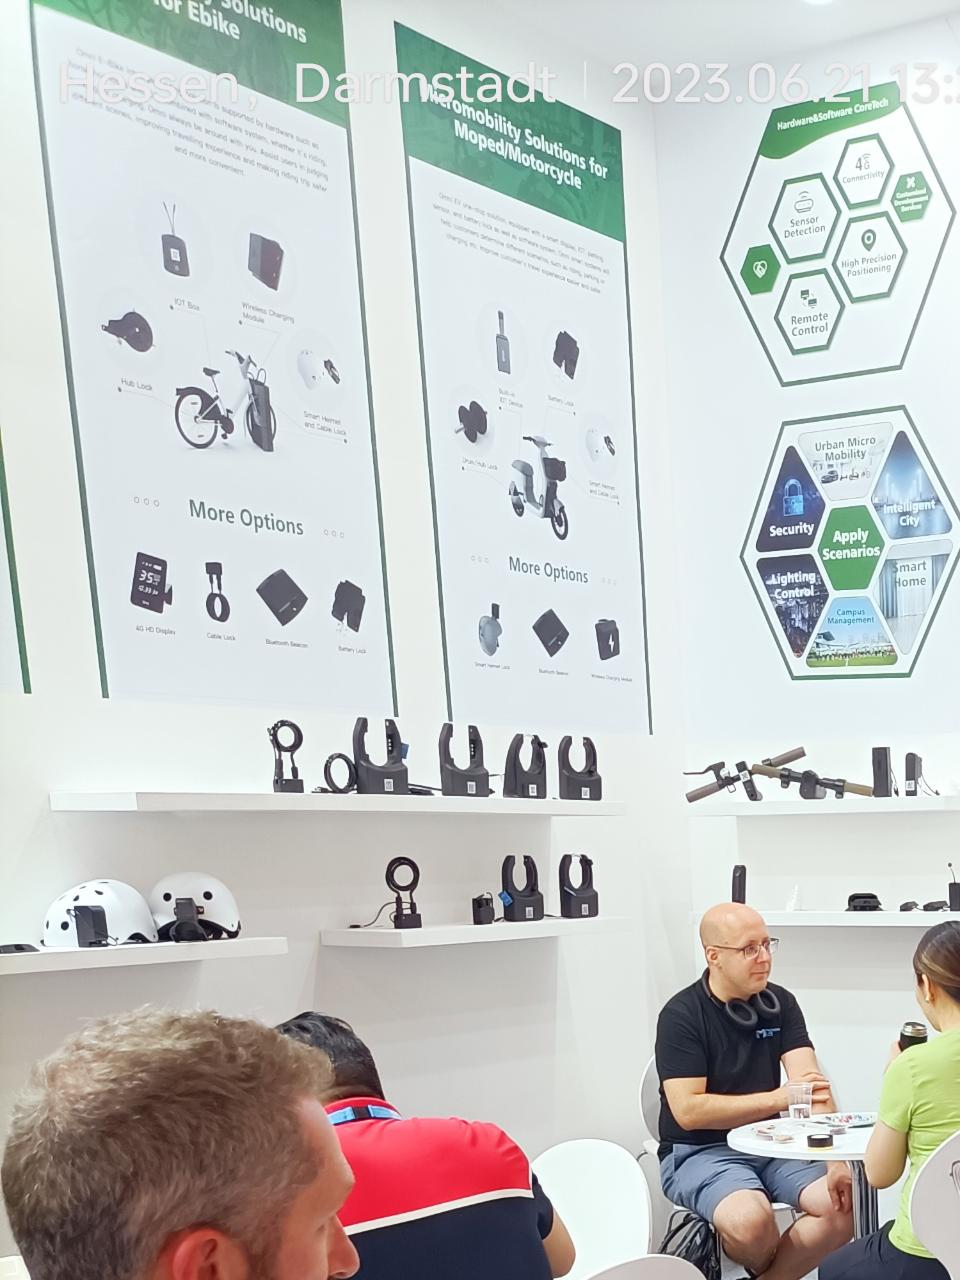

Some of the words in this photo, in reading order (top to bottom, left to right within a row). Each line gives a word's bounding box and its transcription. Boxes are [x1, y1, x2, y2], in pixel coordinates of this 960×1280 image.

[187, 1, 241, 40] Ebike
[777, 106, 853, 131] Hardware&Software
[854, 97, 889, 114] CoreTech
[453, 119, 583, 191] Moped/Motorcycle
[524, 127, 587, 171] Solutions
[589, 156, 609, 180] for
[842, 169, 885, 184] Connectivity
[790, 215, 819, 228] Sensor
[783, 223, 826, 239] Detection
[841, 258, 860, 271] High
[862, 252, 897, 267] Precision
[847, 263, 892, 278] Positioning
[791, 311, 829, 326] Remote
[791, 323, 829, 338] Control
[815, 439, 844, 452] Urban
[847, 435, 876, 448] Micro
[824, 449, 866, 463] Mobility
[883, 499, 936, 516] Intelligent
[189, 498, 235, 524] More
[240, 508, 304, 536] Options
[899, 515, 921, 528] City
[769, 522, 815, 537] Security
[833, 528, 869, 545] Apply
[822, 545, 881, 561] Scenarios
[508, 555, 541, 576] More
[543, 562, 589, 584] Options
[892, 559, 927, 574] Smart
[771, 571, 816, 587] Lighting
[895, 576, 927, 588] Home
[774, 585, 815, 600] Control
[827, 615, 875, 625] Management
[836, 607, 866, 618] Campus
